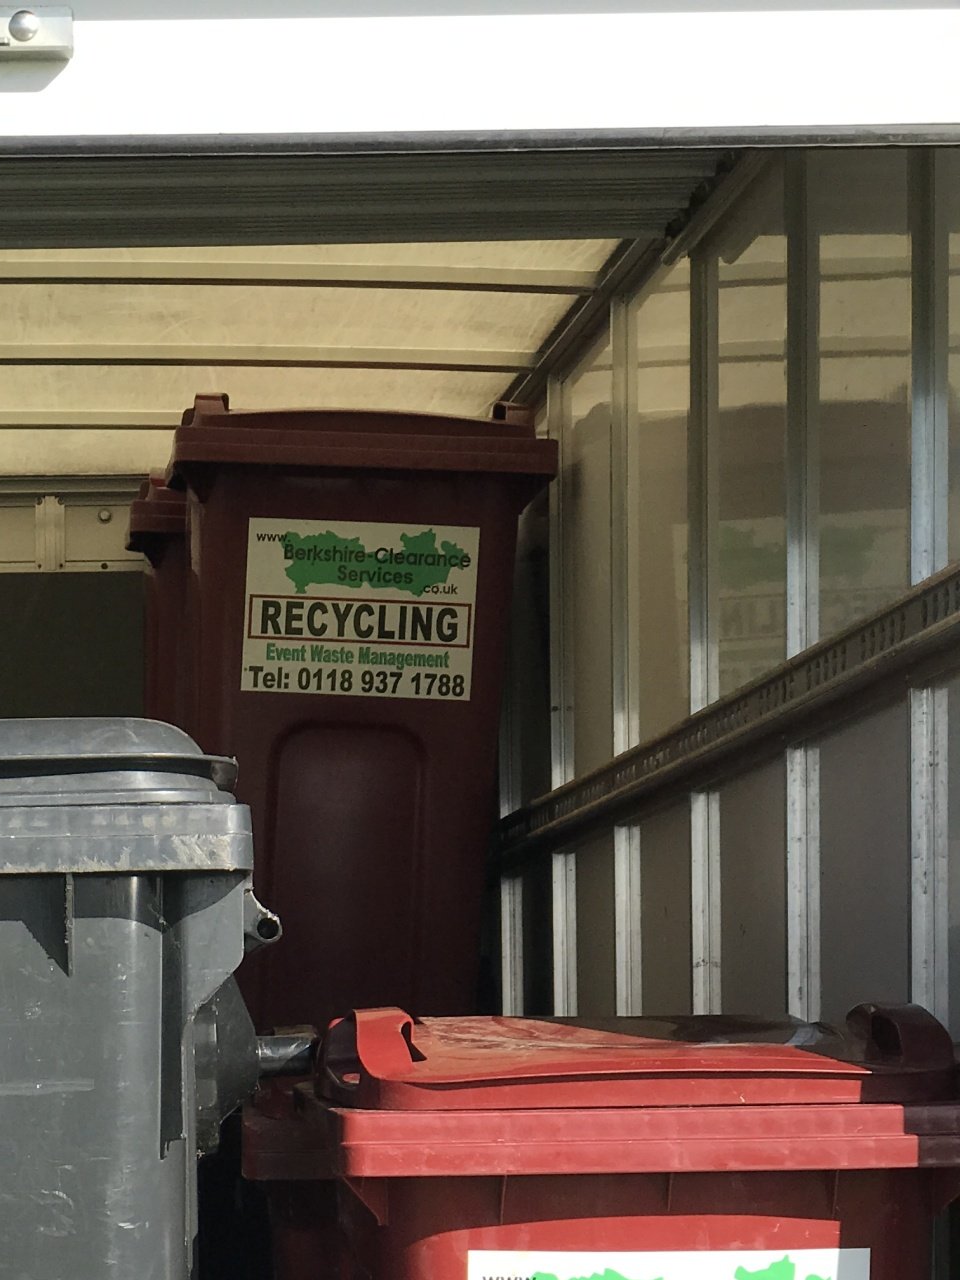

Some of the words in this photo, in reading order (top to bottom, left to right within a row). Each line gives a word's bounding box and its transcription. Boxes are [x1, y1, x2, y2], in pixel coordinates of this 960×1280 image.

[283, 545, 471, 568] Berkshire-Clearance
[337, 566, 413, 584] Services
[260, 600, 458, 643] RECYCLING
[266, 643, 306, 662] Event
[311, 645, 354, 664] Waste
[358, 647, 449, 670] Management
[248, 665, 290, 689] Tel:
[298, 668, 353, 693] 0118
[361, 671, 402, 694] 937
[411, 672, 465, 697] 1788
